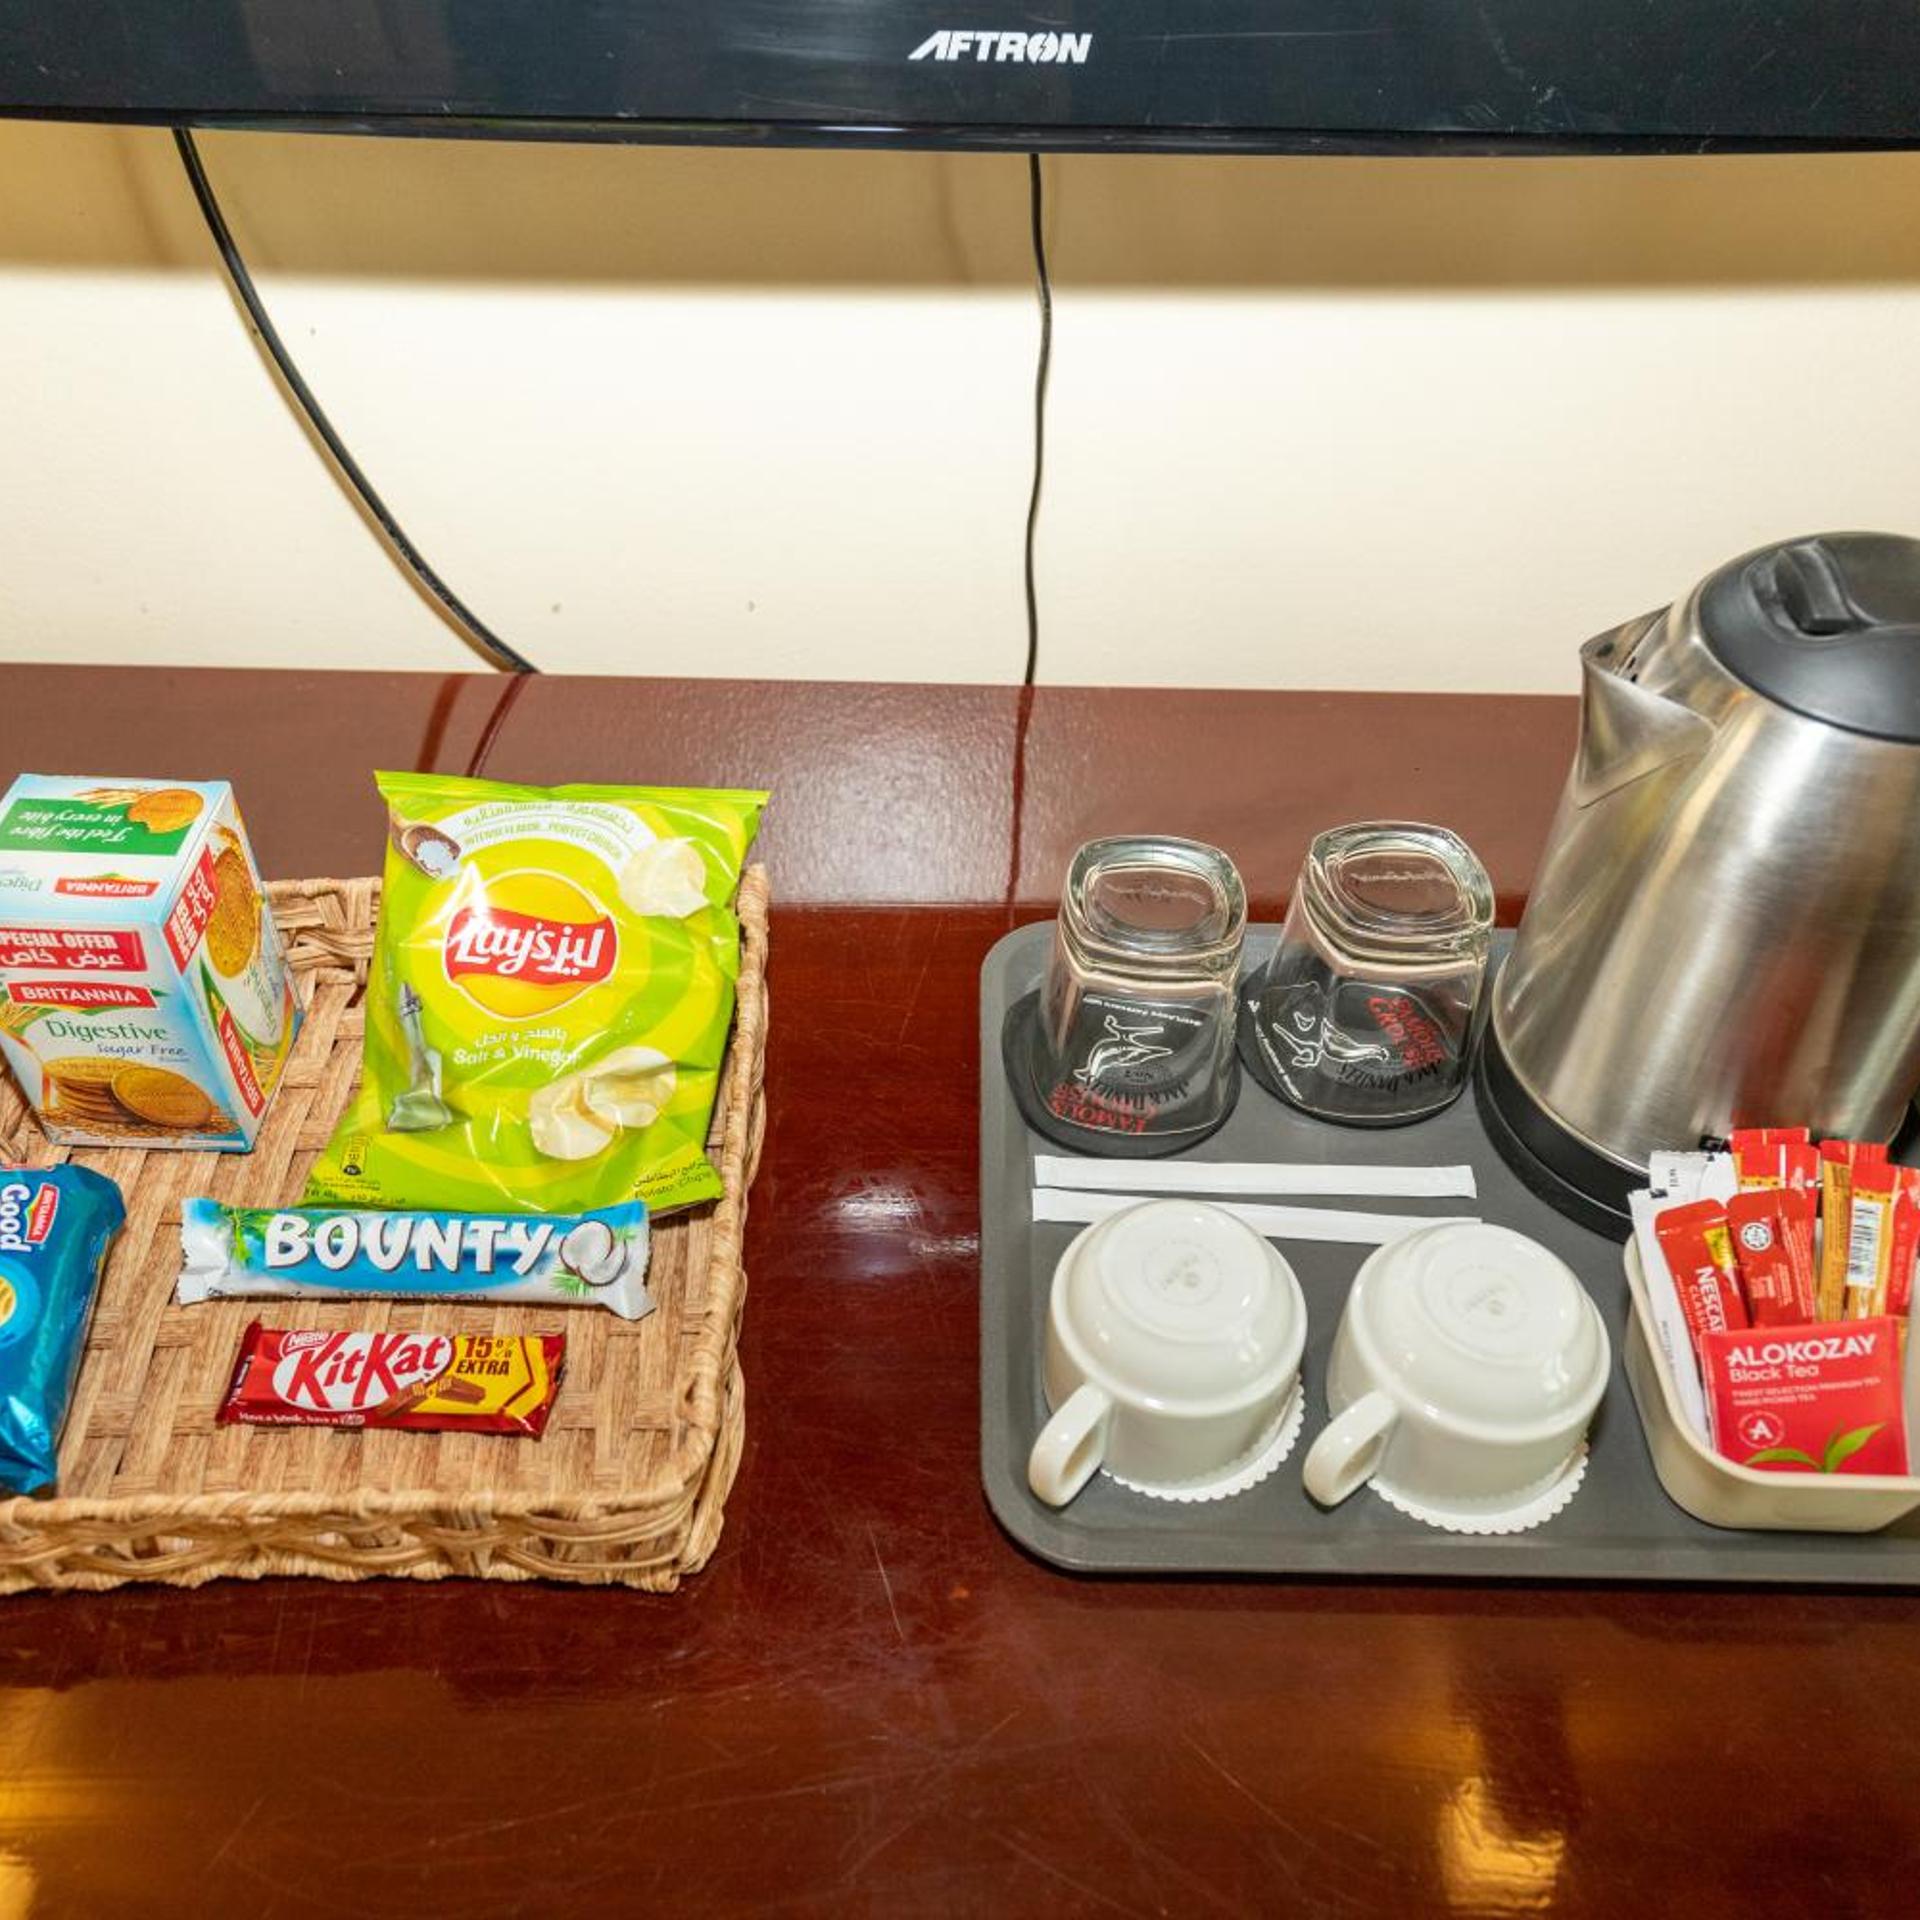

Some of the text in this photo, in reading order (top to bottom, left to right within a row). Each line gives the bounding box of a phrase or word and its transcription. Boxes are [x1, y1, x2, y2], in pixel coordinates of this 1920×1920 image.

[907, 30, 1093, 64] AFTRON
[56, 809, 104, 822] every
[66, 881, 149, 895] BRITANNIA
[0, 931, 118, 949] PECIAL OFFER
[450, 917, 556, 975] Lay's
[0, 948, 124, 969] عرض خاص
[536, 925, 606, 977] ليز
[20, 986, 141, 1003] BRITANNIA
[45, 1020, 169, 1042] Digestive
[98, 1043, 186, 1058] Sugar Free
[454, 1048, 489, 1064] Salt
[0, 1184, 32, 1253] Good
[264, 1212, 554, 1277] BOUNTY
[1725, 1333, 1877, 1367] ALOKOZAY
[286, 1331, 447, 1409] KitKat
[456, 1359, 510, 1375] EXTRA
[1729, 1364, 1820, 1383] Black Tea
